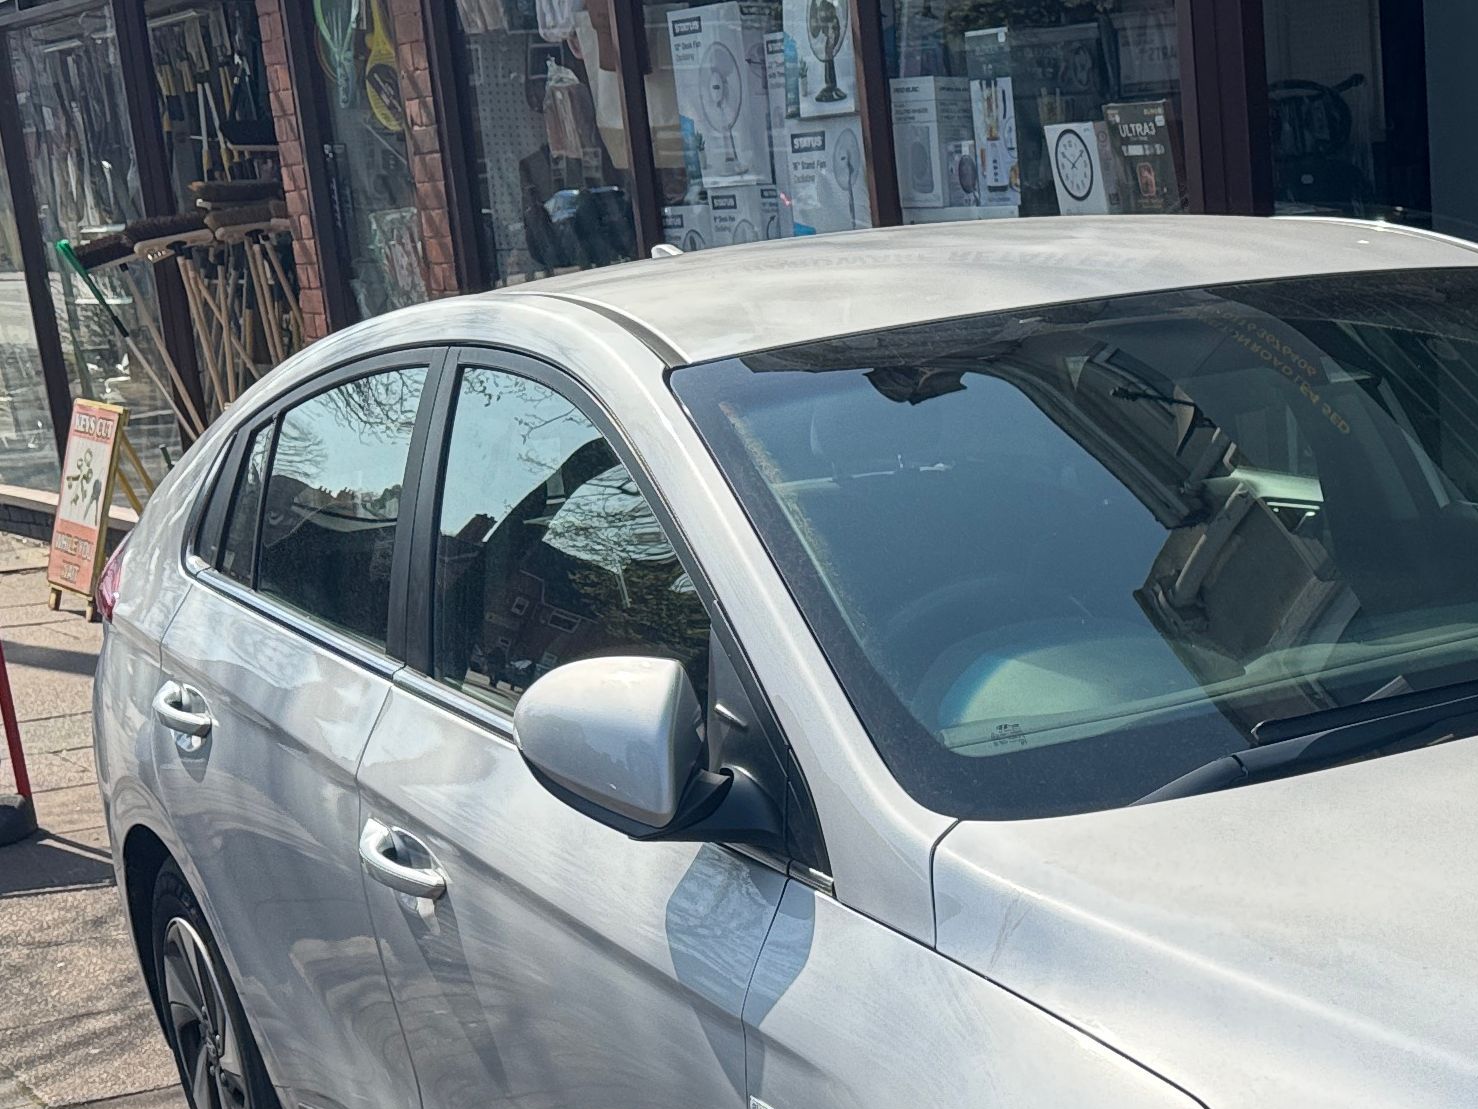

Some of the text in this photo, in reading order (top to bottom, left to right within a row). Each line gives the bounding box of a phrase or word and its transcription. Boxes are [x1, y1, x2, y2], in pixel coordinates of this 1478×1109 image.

[1119, 122, 1156, 138] ULTRA3
[793, 134, 823, 149] STATUS
[74, 413, 114, 440] KEYS CUT
